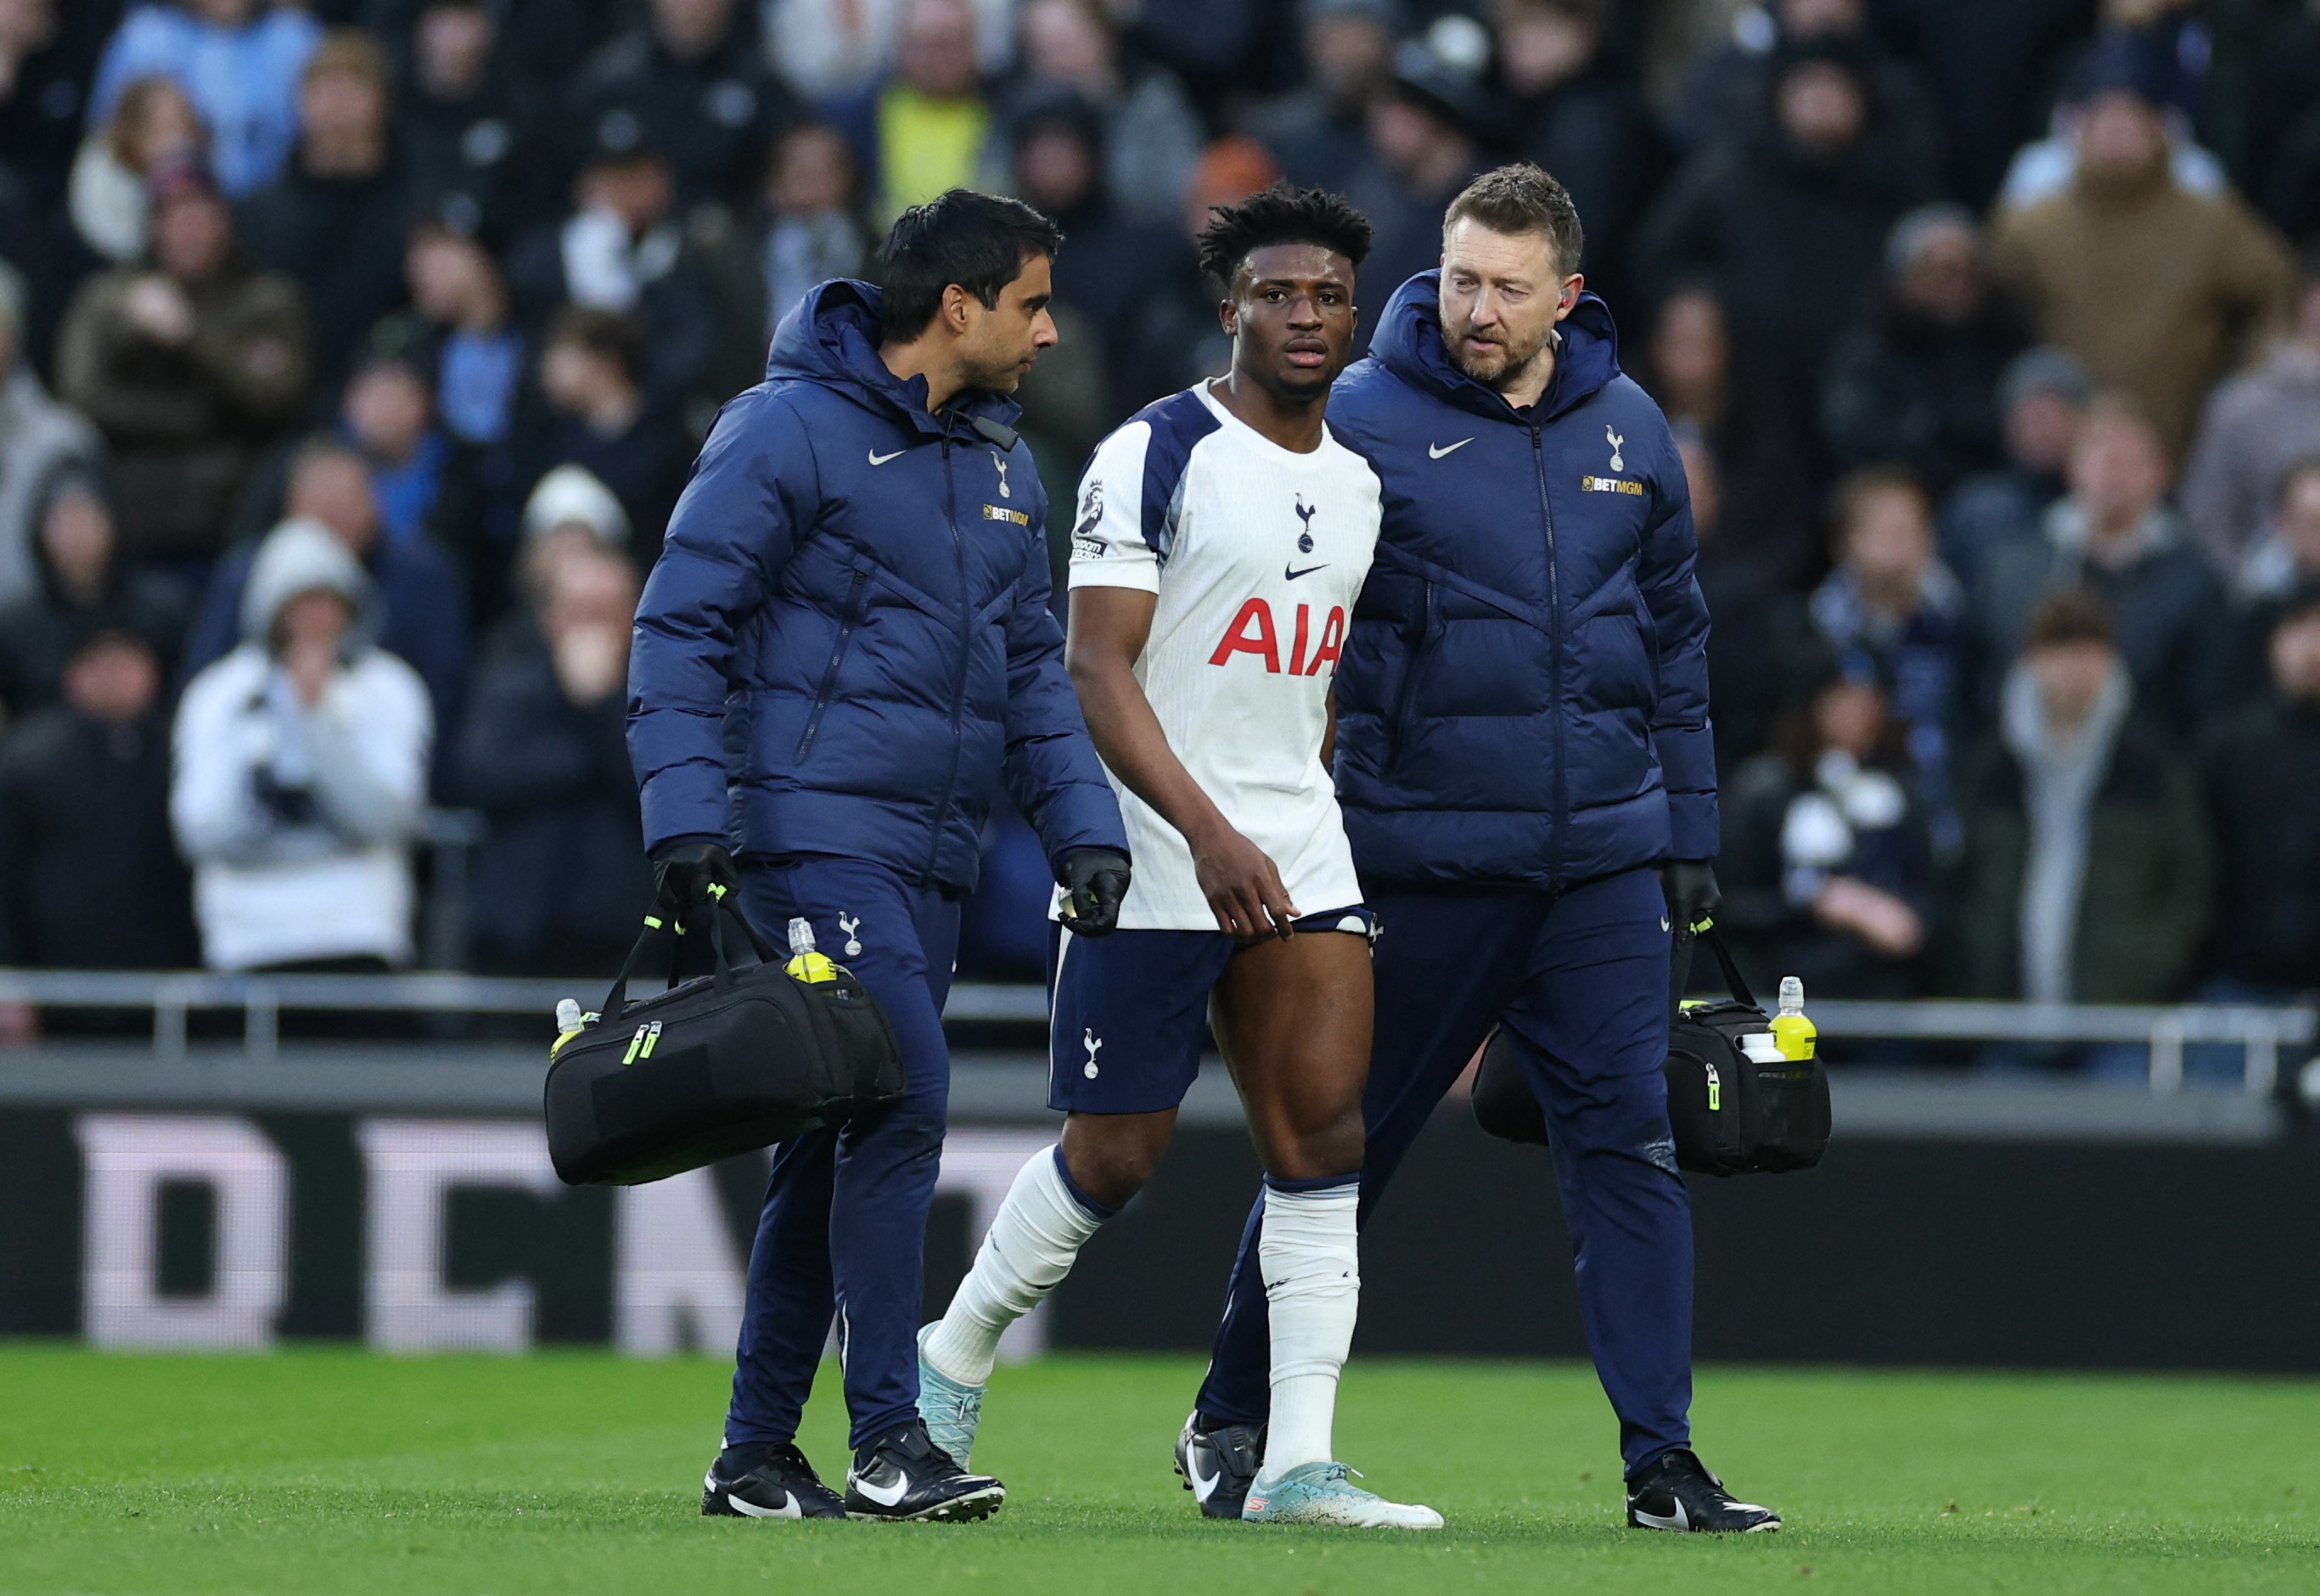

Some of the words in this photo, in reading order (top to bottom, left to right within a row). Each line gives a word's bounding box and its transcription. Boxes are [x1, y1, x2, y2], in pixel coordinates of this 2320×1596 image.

[1593, 477, 1643, 496] BETMGM
[991, 506, 1029, 526] BETMGM
[1208, 598, 1345, 677] AIA
